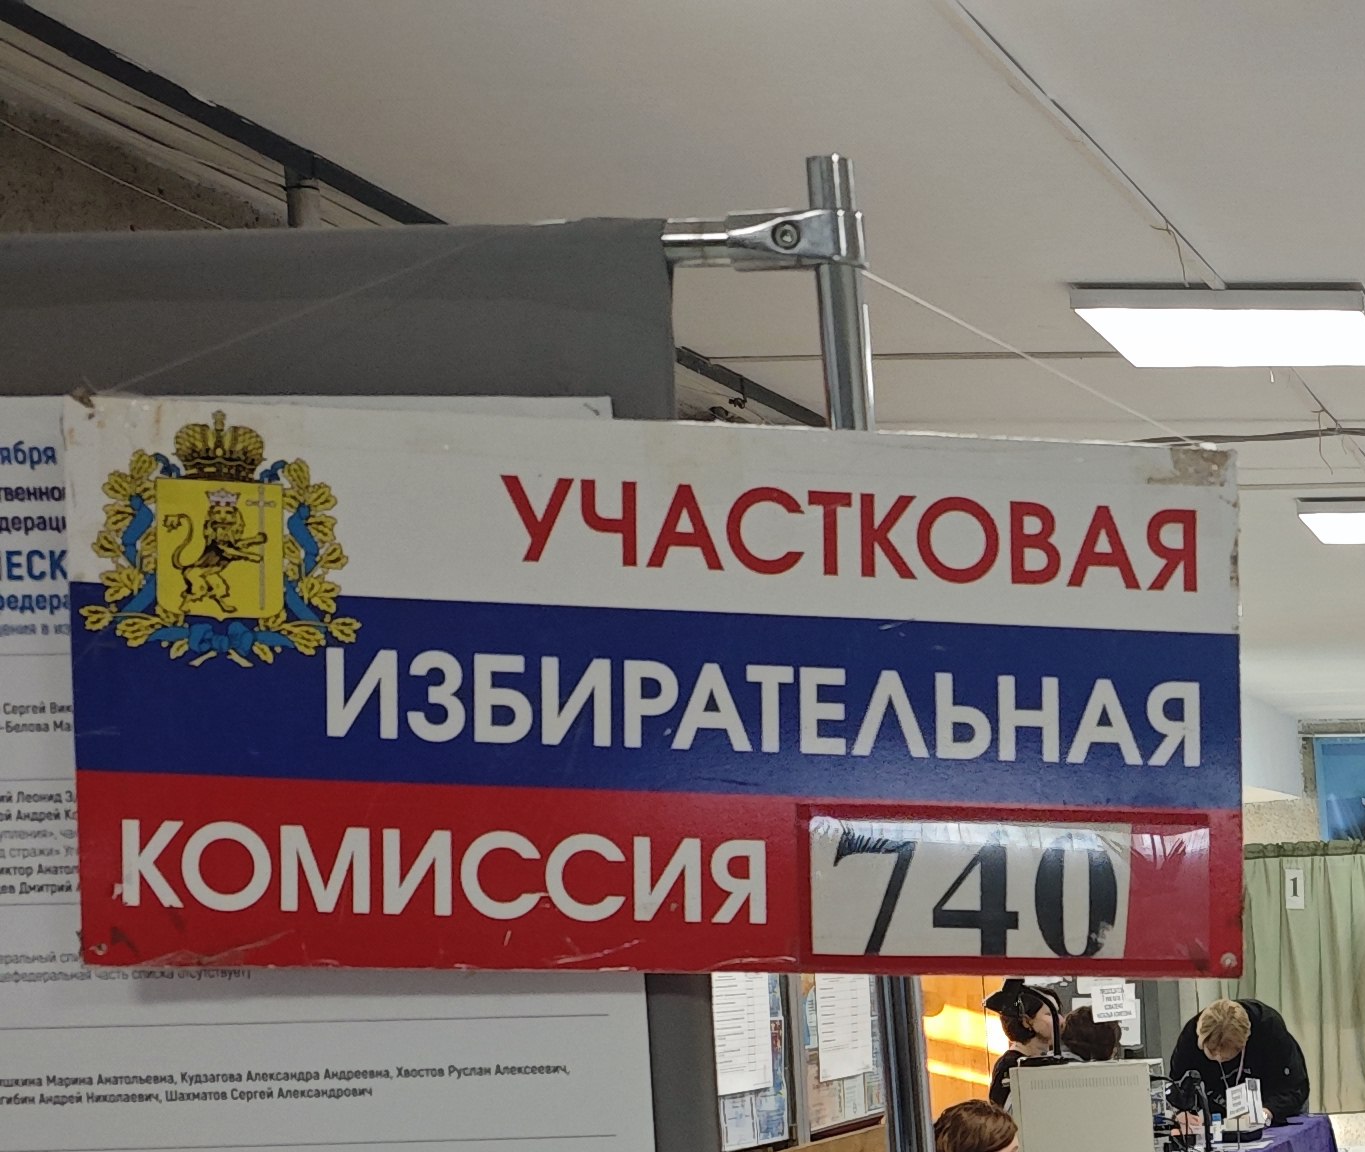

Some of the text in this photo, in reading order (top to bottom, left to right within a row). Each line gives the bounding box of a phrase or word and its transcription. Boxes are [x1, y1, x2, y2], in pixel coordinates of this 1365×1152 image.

[0, 549, 68, 581] ЕСК
[500, 474, 1198, 592] УЧАСТКОВАЯ
[324, 647, 1201, 767] ИЗБИРАТЕЛЬНАЯ
[117, 818, 1118, 959] КОМИССИЯ 740
[1290, 876, 1300, 898] 1
